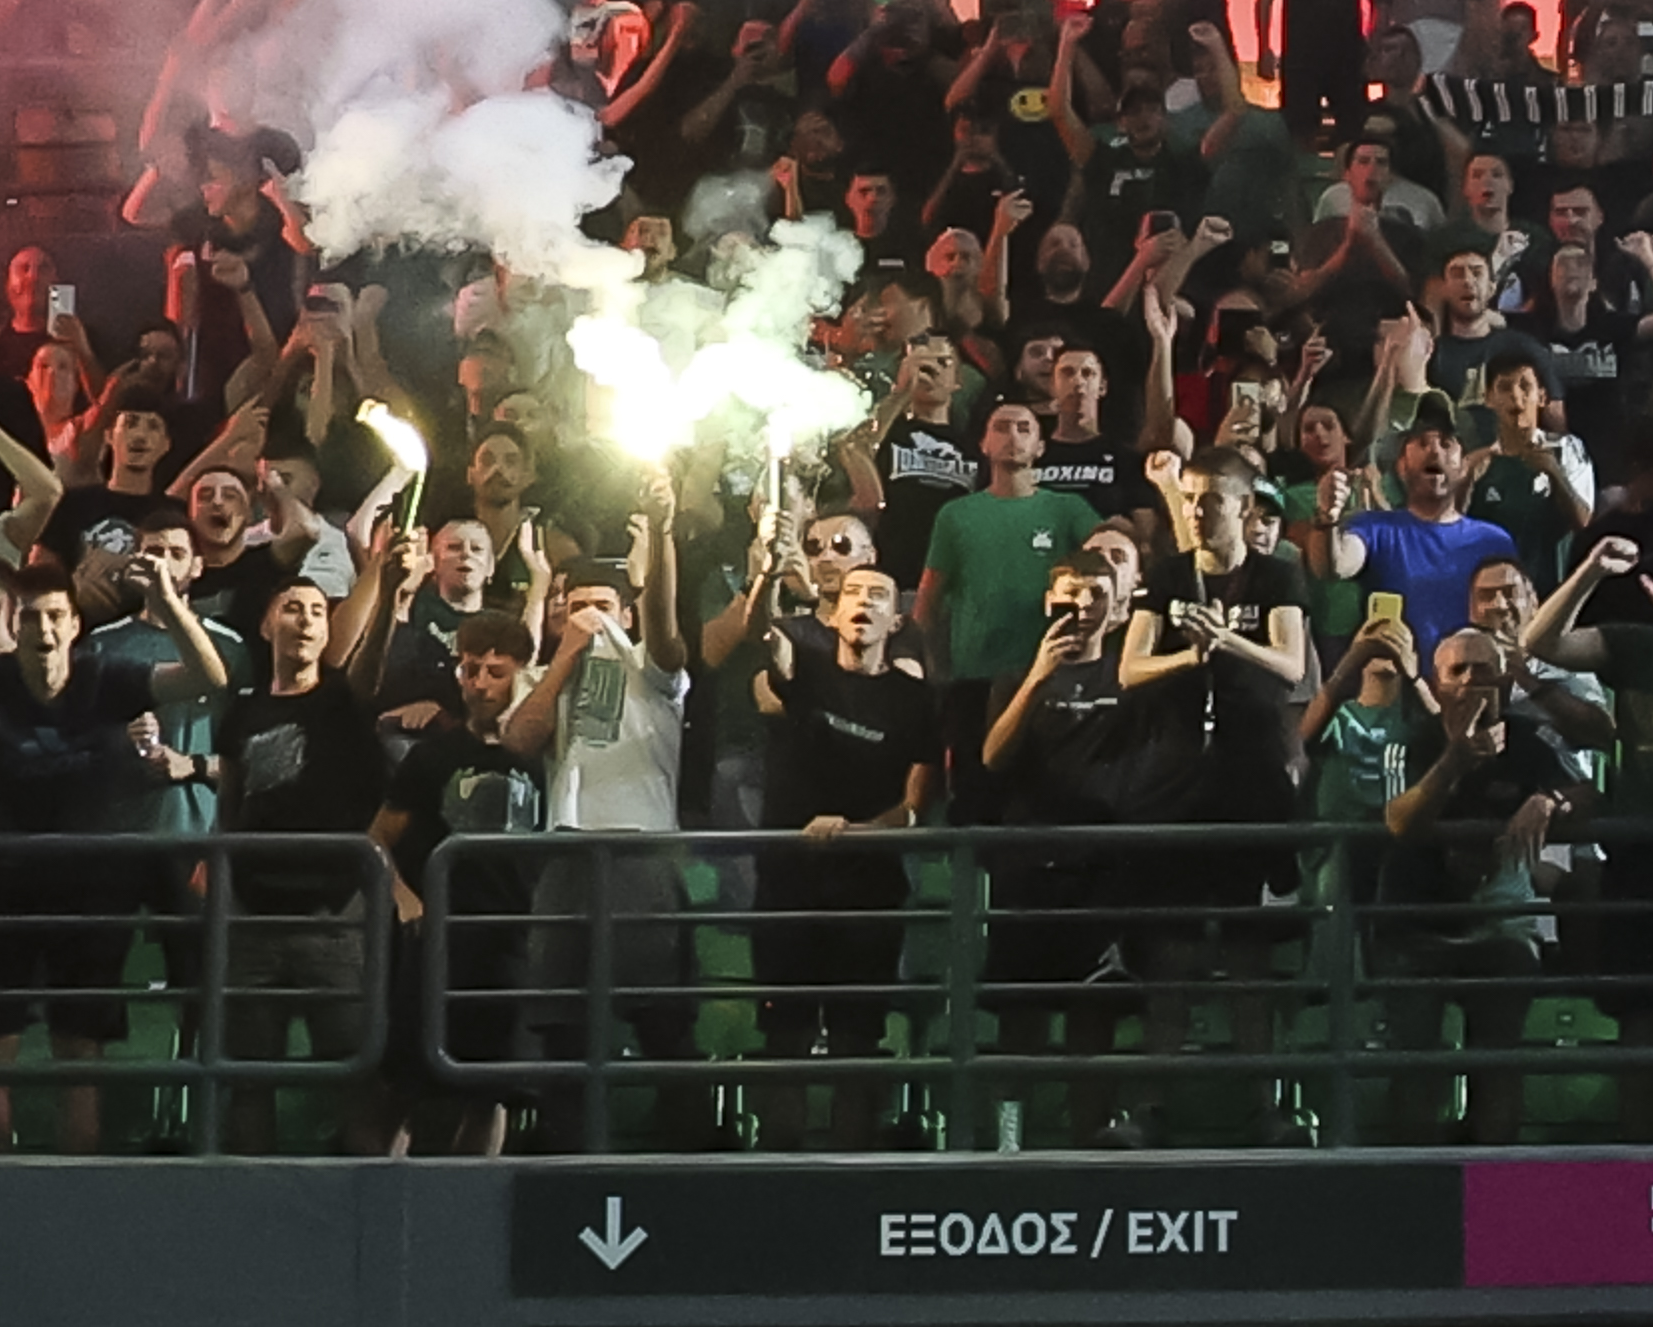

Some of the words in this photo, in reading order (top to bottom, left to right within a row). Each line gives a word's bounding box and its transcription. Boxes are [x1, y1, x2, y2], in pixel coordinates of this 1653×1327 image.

[881, 1213, 1077, 1255] ΕΞΟΔΟΣ
[1091, 1209, 1113, 1258] /
[1129, 1211, 1237, 1253] EXIT
